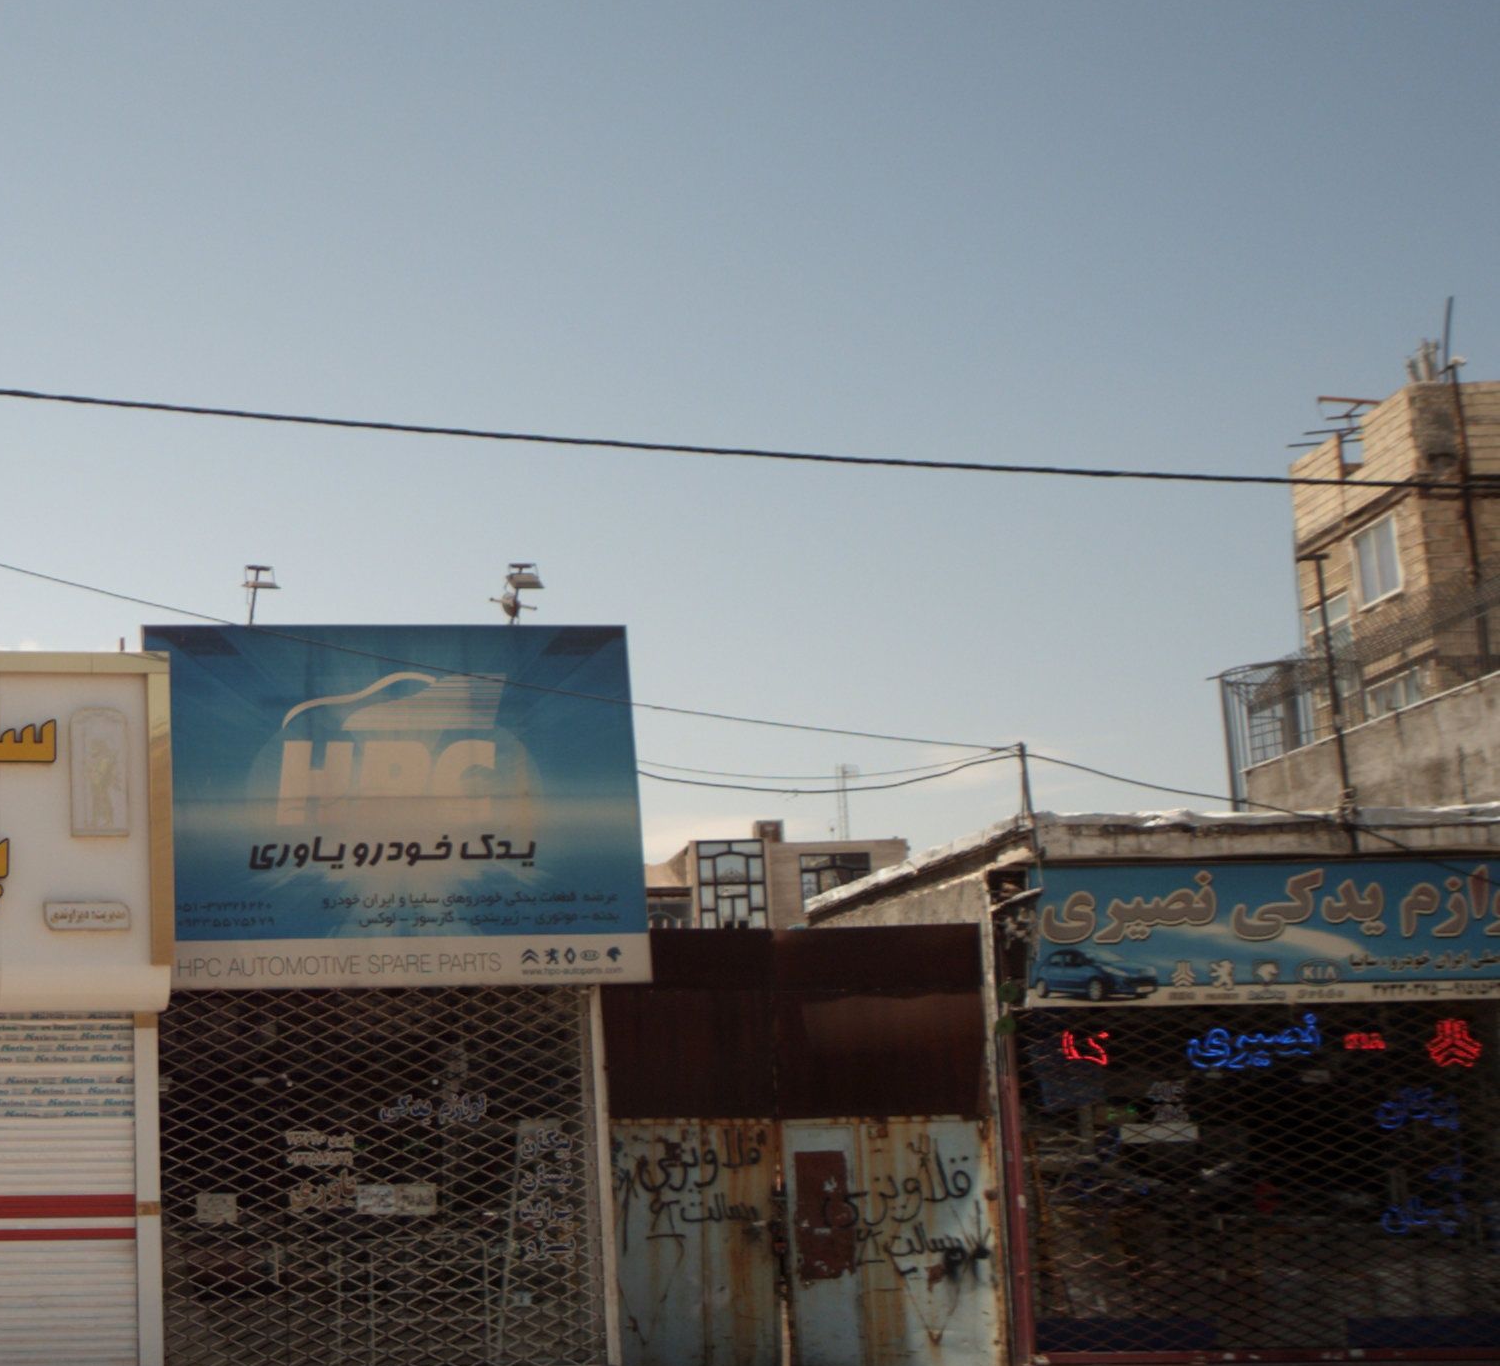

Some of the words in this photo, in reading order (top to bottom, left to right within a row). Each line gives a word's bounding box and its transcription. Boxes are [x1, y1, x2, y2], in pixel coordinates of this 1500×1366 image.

[276, 739, 497, 826] HPC
[249, 836, 346, 871] یاوری
[354, 835, 453, 868] خودرو
[459, 833, 537, 867] یدک
[322, 894, 360, 909] خودرو
[363, 893, 395, 908] ایران
[504, 891, 537, 906] یدکی
[1040, 870, 1217, 945] نصیری
[1232, 867, 1386, 940] یدکی
[177, 957, 221, 978] HPC
[227, 954, 361, 977] AUTOMOTIVE
[369, 953, 431, 975] SPARE
[439, 951, 502, 973] PARTS
[1302, 963, 1338, 980] KIA
